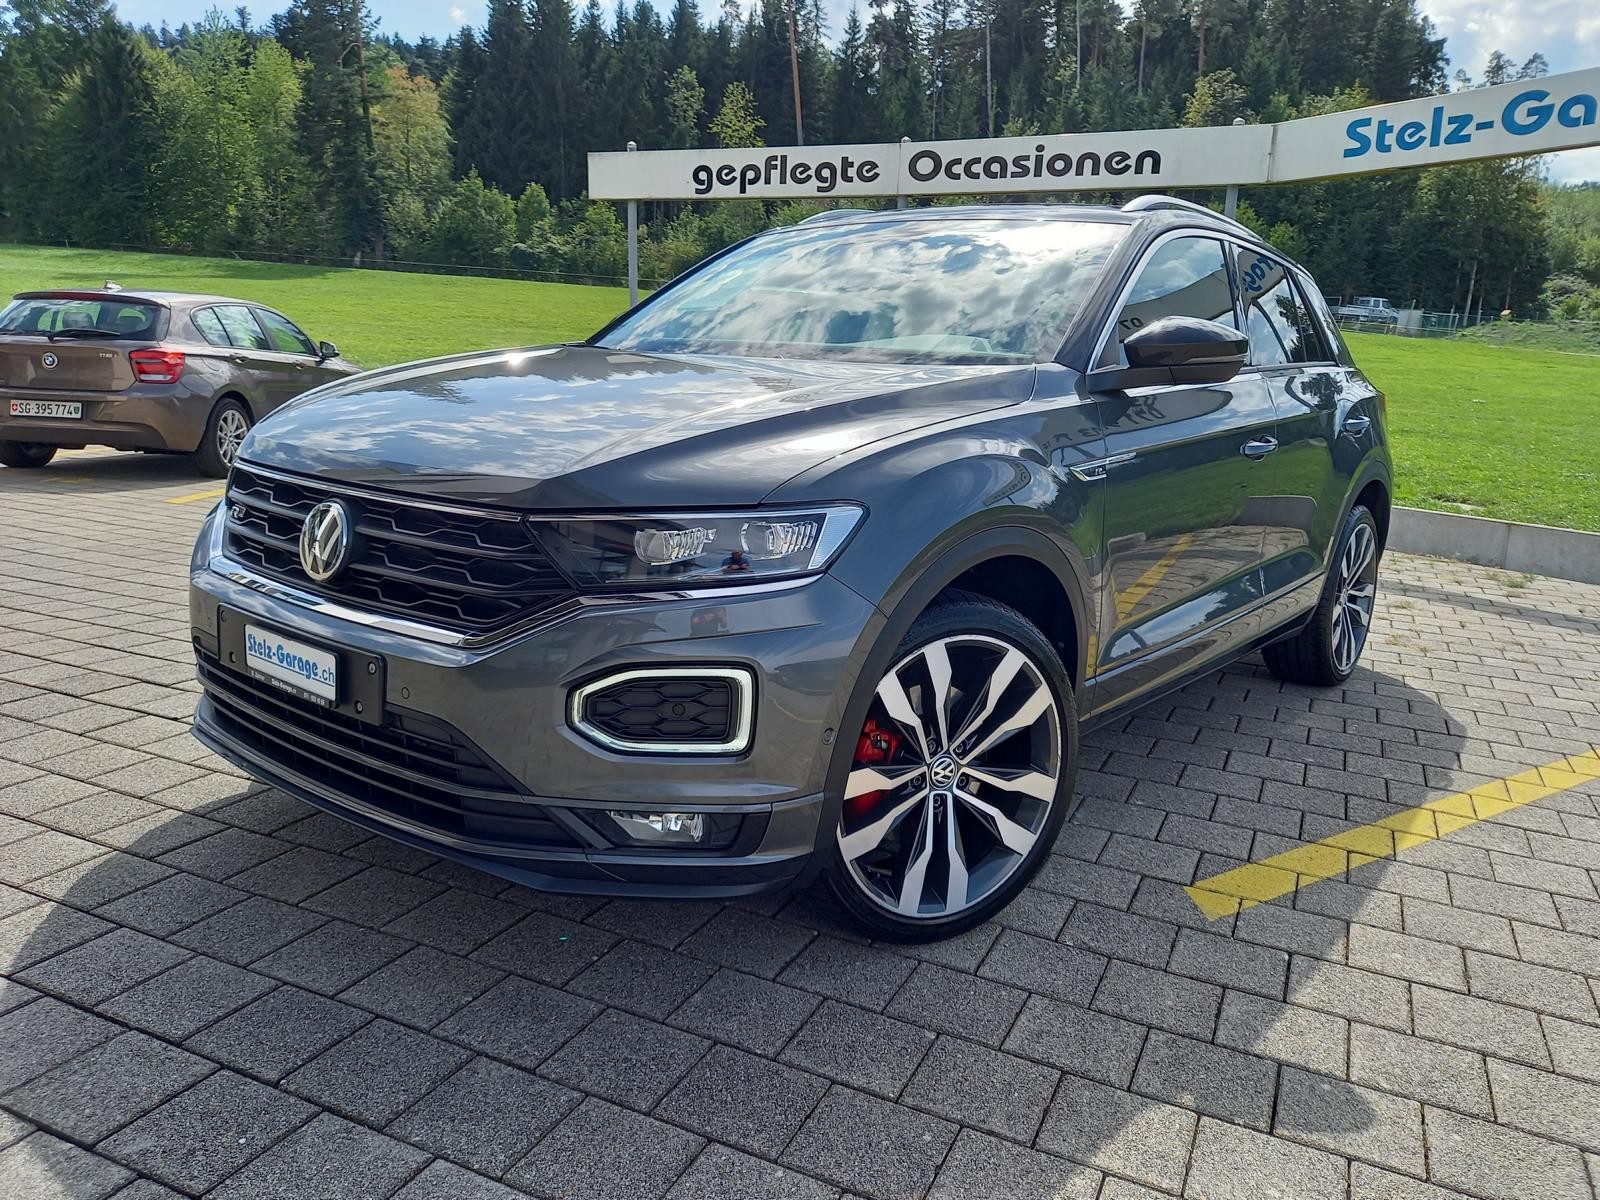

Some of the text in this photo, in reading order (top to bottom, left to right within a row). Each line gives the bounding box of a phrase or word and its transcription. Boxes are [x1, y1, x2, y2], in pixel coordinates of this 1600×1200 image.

[1343, 89, 1598, 158] Stelz-Ga
[693, 144, 1161, 195] gepflegte Occasionen
[247, 633, 335, 684] Stelz-Garage.ch
